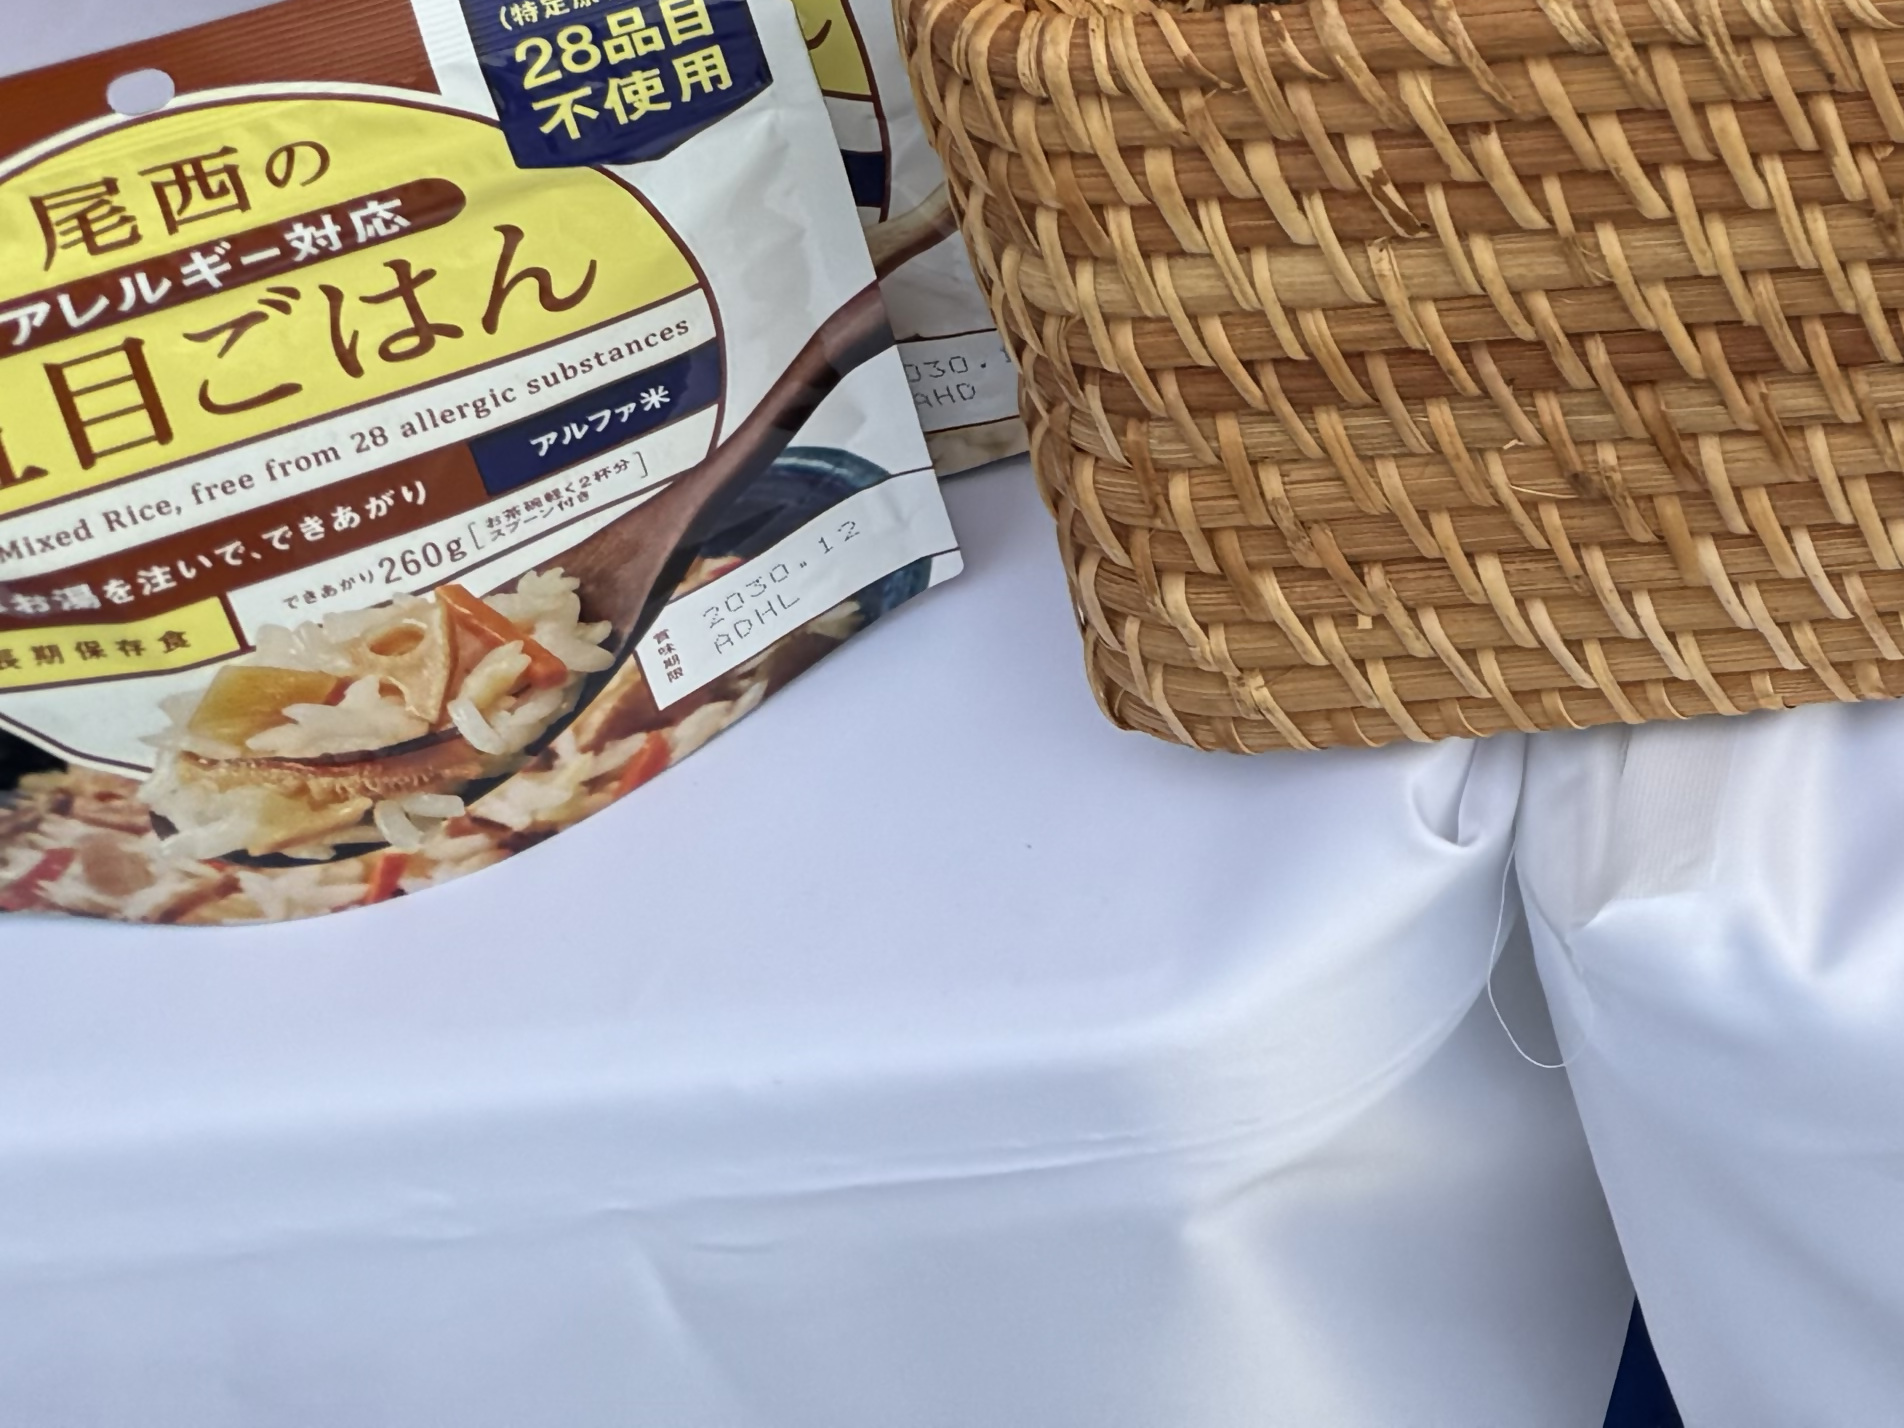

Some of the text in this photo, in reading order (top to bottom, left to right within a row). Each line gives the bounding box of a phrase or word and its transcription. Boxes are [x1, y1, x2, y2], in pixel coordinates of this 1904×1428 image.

[531, 44, 734, 140] 不使用
[29, 140, 331, 272] 尾西の
[0, 198, 412, 346] アレルギー対応
[0, 317, 690, 566] Mixed Rice, free from 28 allergic substances
[529, 384, 671, 458] アルファ米
[0, 480, 428, 615] お湯を注いで、できあがり
[490, 491, 591, 542] スプーン付き
[283, 535, 468, 612] できあがり 260g
[701, 520, 861, 629] 2030.12
[652, 628, 685, 684] 賞味期限
[713, 594, 801, 654] ADHL
